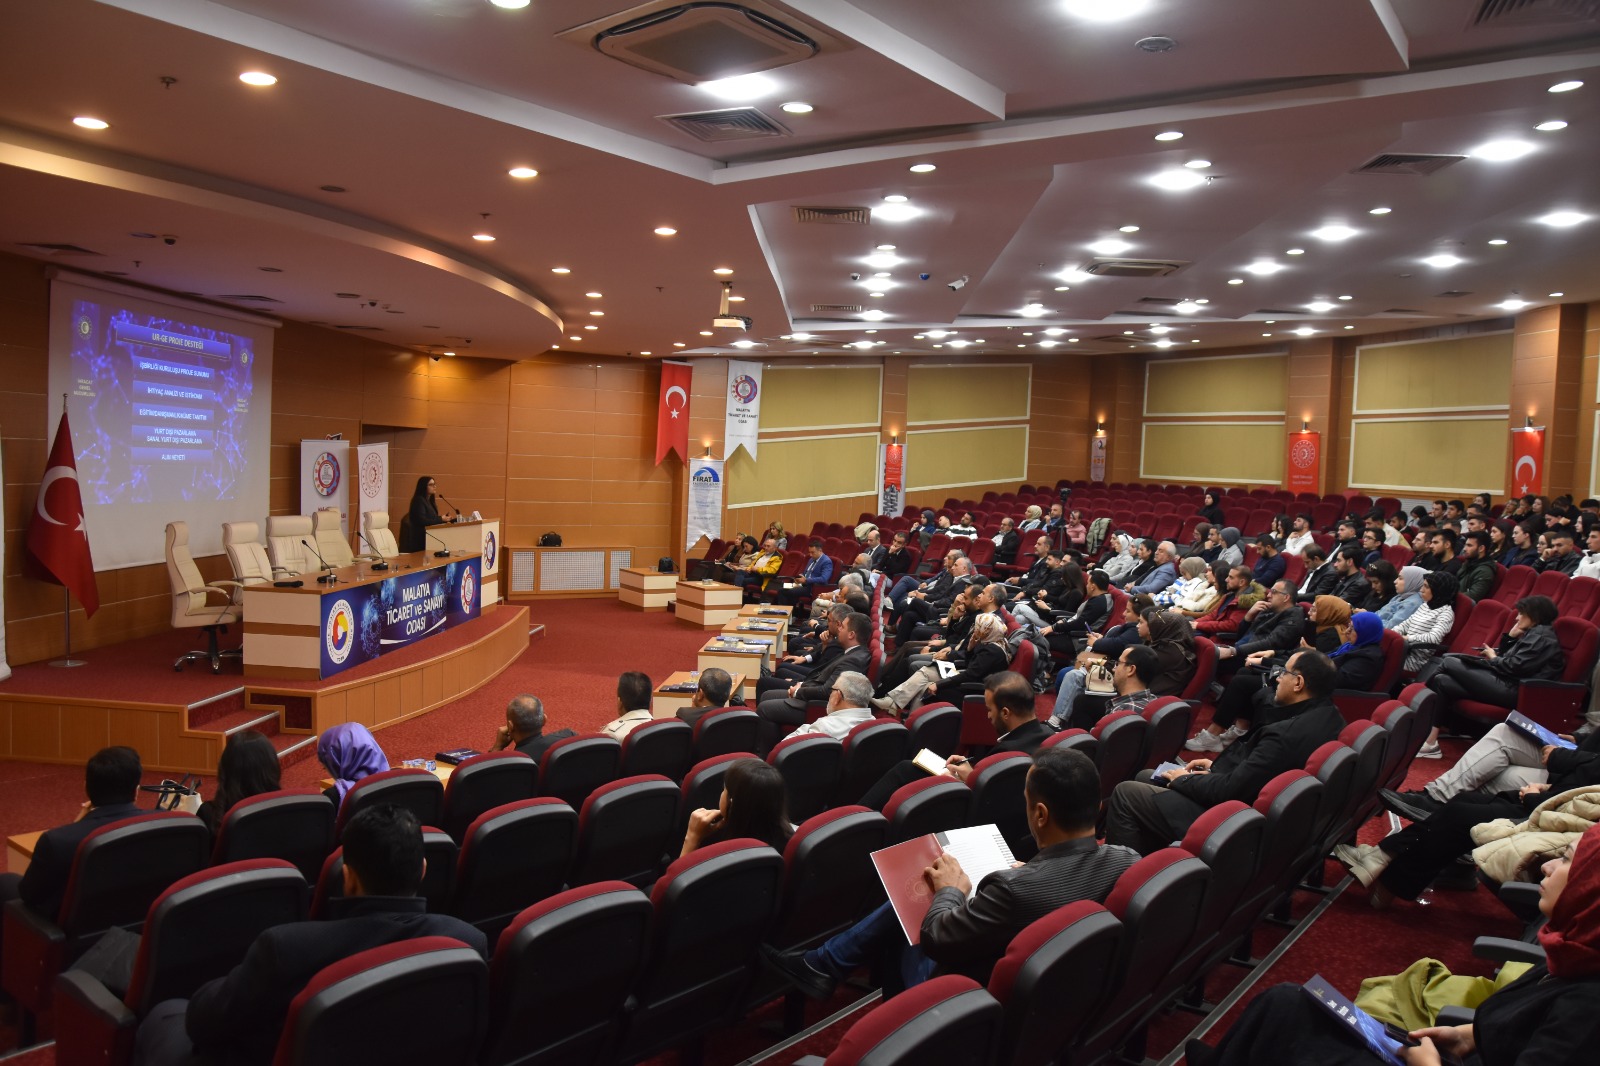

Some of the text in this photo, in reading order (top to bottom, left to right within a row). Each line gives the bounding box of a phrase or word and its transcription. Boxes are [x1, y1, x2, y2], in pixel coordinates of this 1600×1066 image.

[152, 333, 168, 342] UR-GE
[169, 336, 183, 346] PROJE
[402, 582, 430, 603] MALATYA
[386, 604, 414, 626] TİCARET
[414, 604, 422, 616] ve
[406, 616, 427, 636] ODASI
